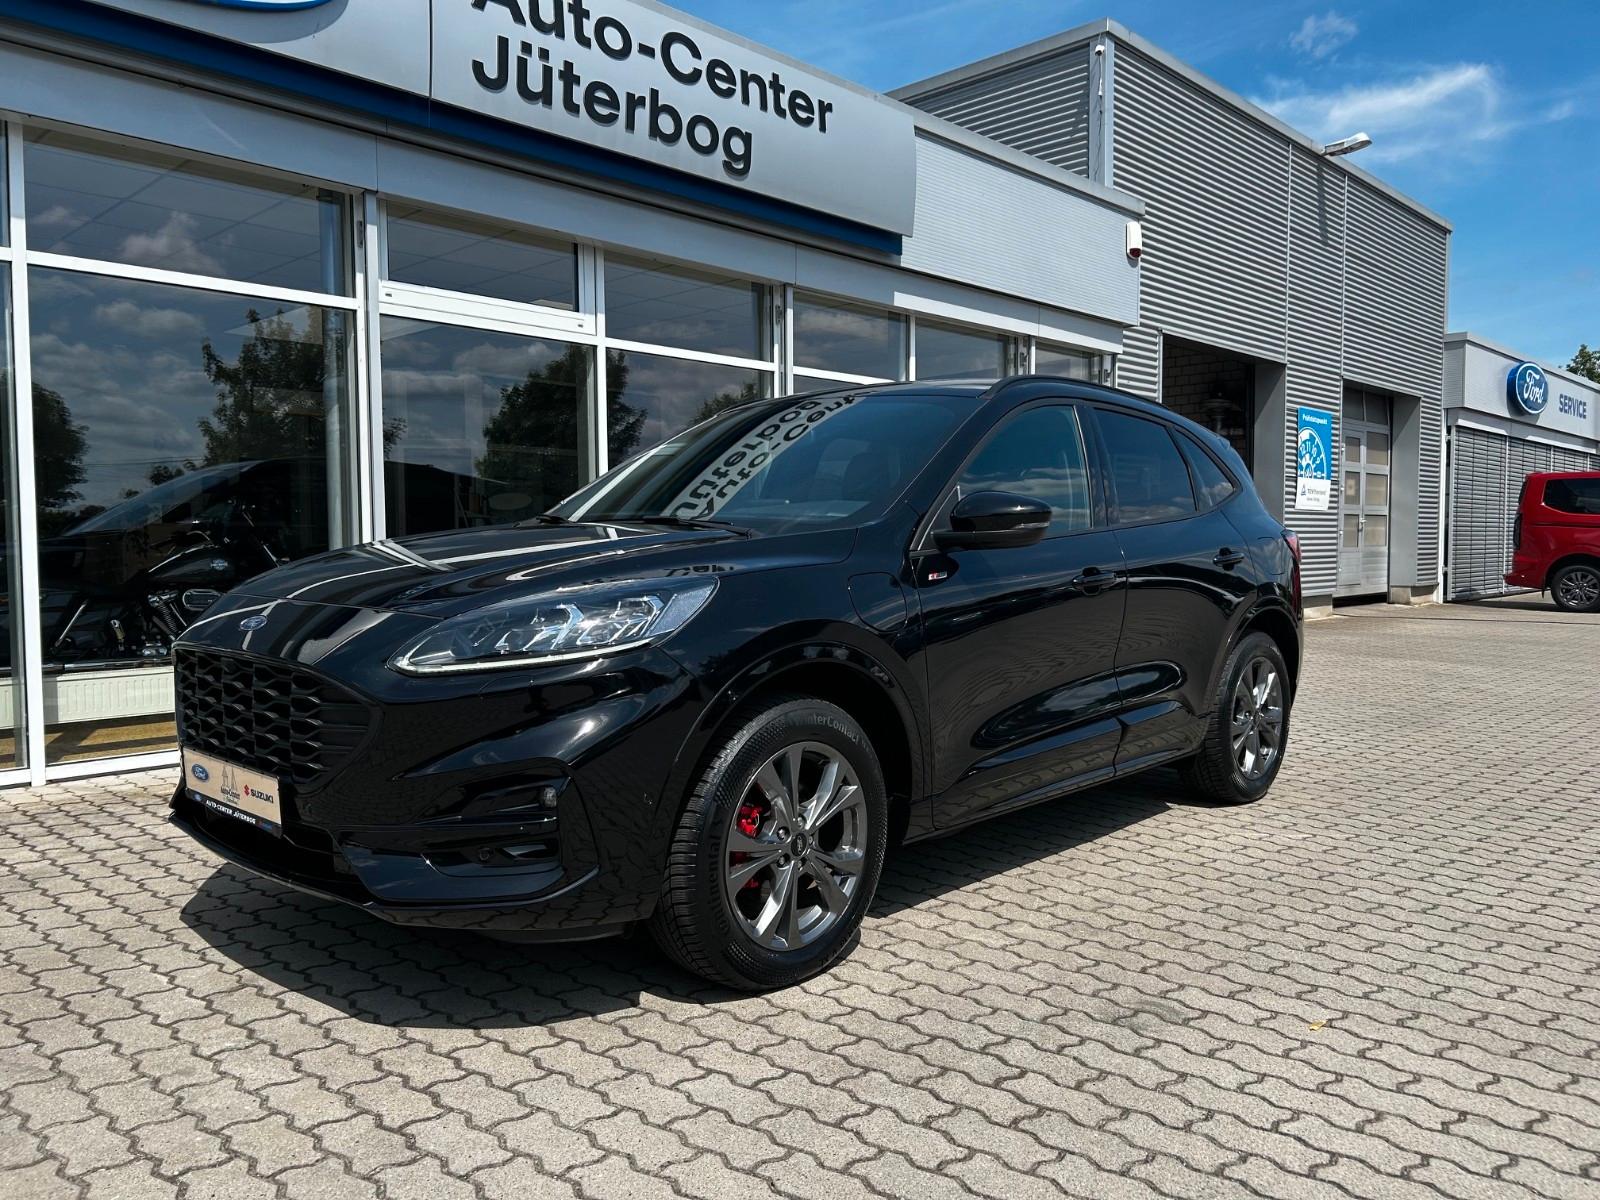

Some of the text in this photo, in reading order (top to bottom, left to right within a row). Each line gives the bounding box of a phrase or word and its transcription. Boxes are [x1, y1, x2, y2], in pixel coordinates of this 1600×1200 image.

[472, 35, 753, 177] Jüterbog
[1523, 369, 1545, 404] Ford
[1559, 393, 1587, 419] SERVICE
[250, 788, 274, 804] SUZUKI
